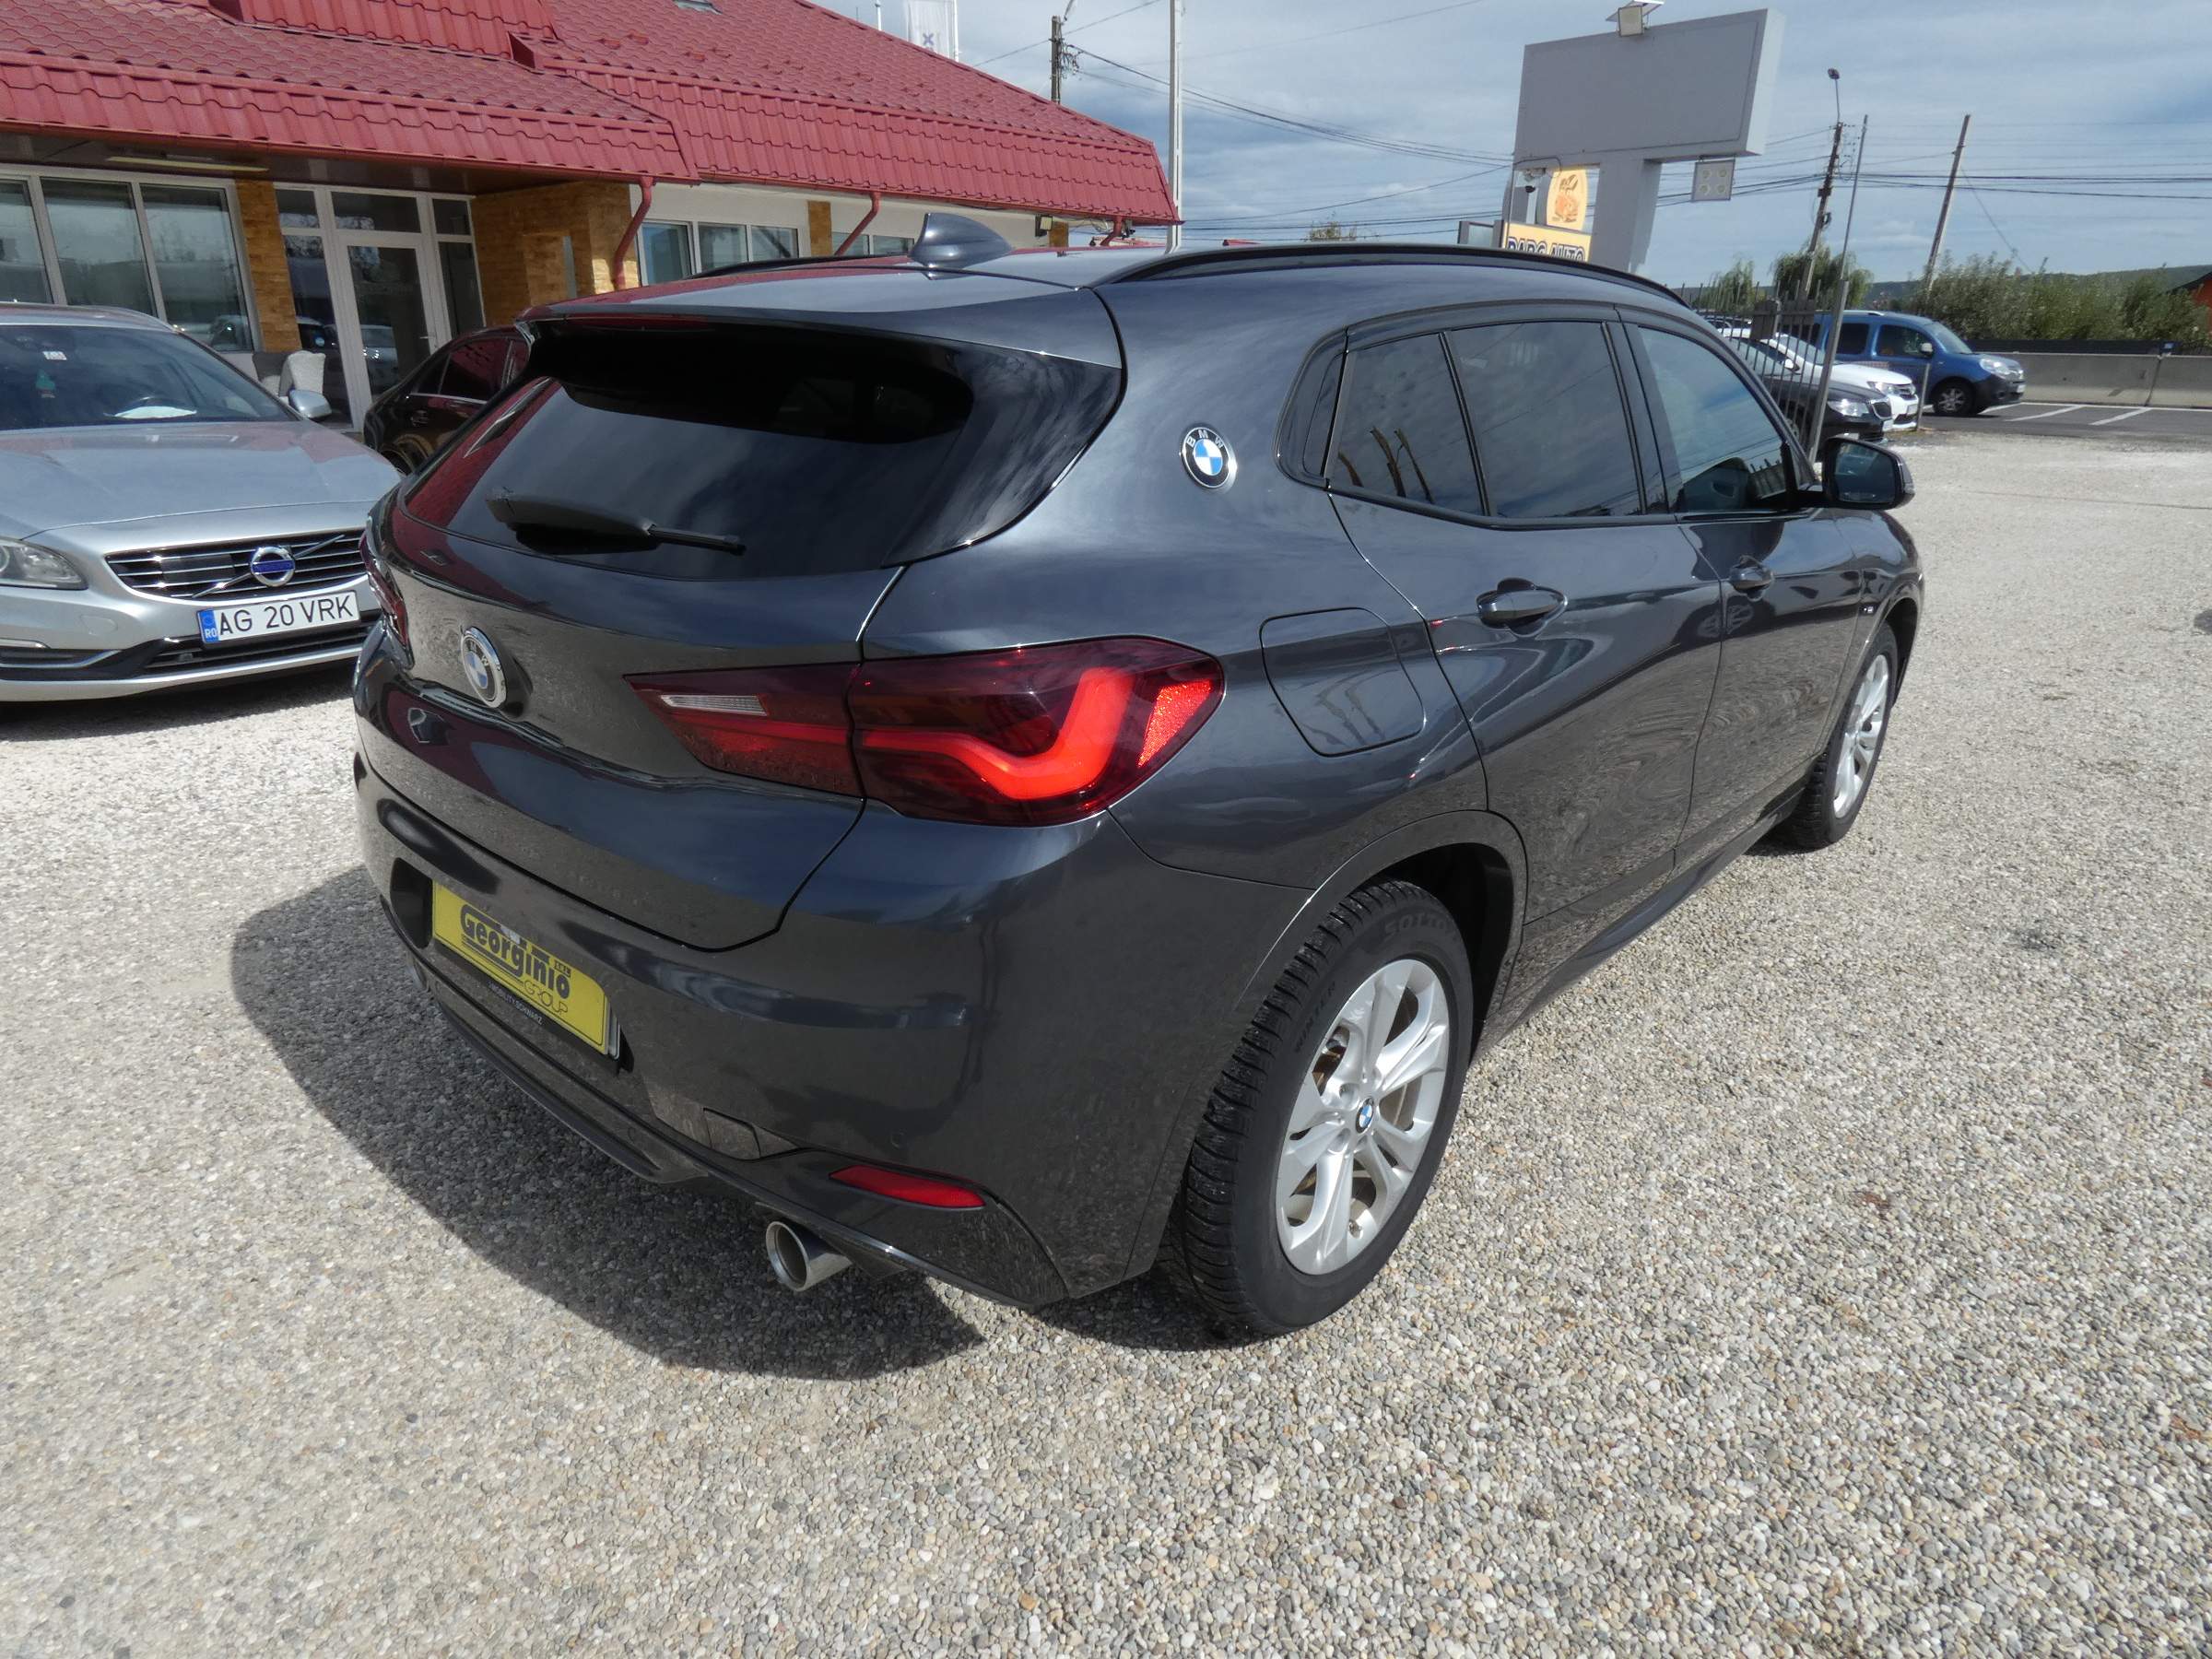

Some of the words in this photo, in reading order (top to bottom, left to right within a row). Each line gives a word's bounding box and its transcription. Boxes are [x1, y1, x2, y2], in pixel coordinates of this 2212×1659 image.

[1186, 429, 1225, 448] BMW
[219, 609, 253, 635] AG
[264, 604, 294, 629] 20
[300, 594, 354, 623] VRK
[205, 628, 218, 638] RO
